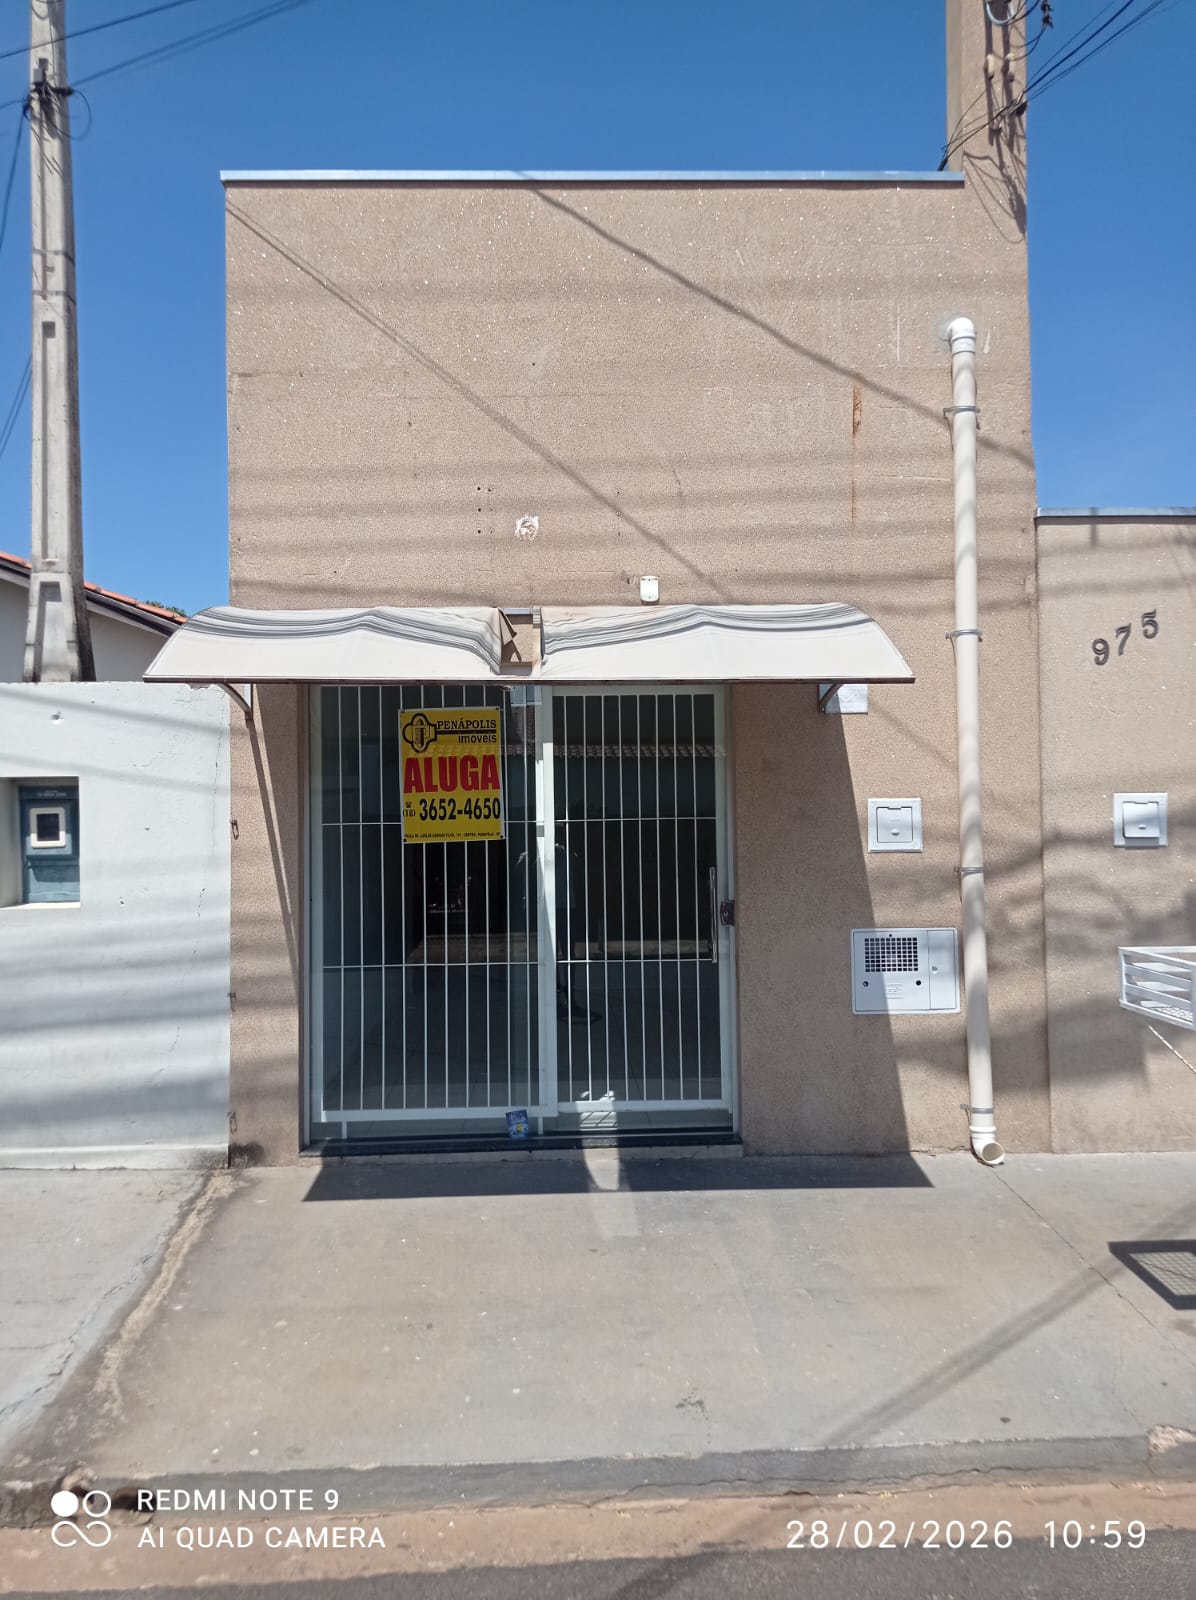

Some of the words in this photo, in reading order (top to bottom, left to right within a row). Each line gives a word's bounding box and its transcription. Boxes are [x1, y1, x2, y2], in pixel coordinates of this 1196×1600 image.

[1092, 608, 1158, 666] 975
[436, 718, 497, 730] PENÁPOLIS
[403, 754, 501, 794] ALUGA
[419, 797, 501, 821] 3652-4650
